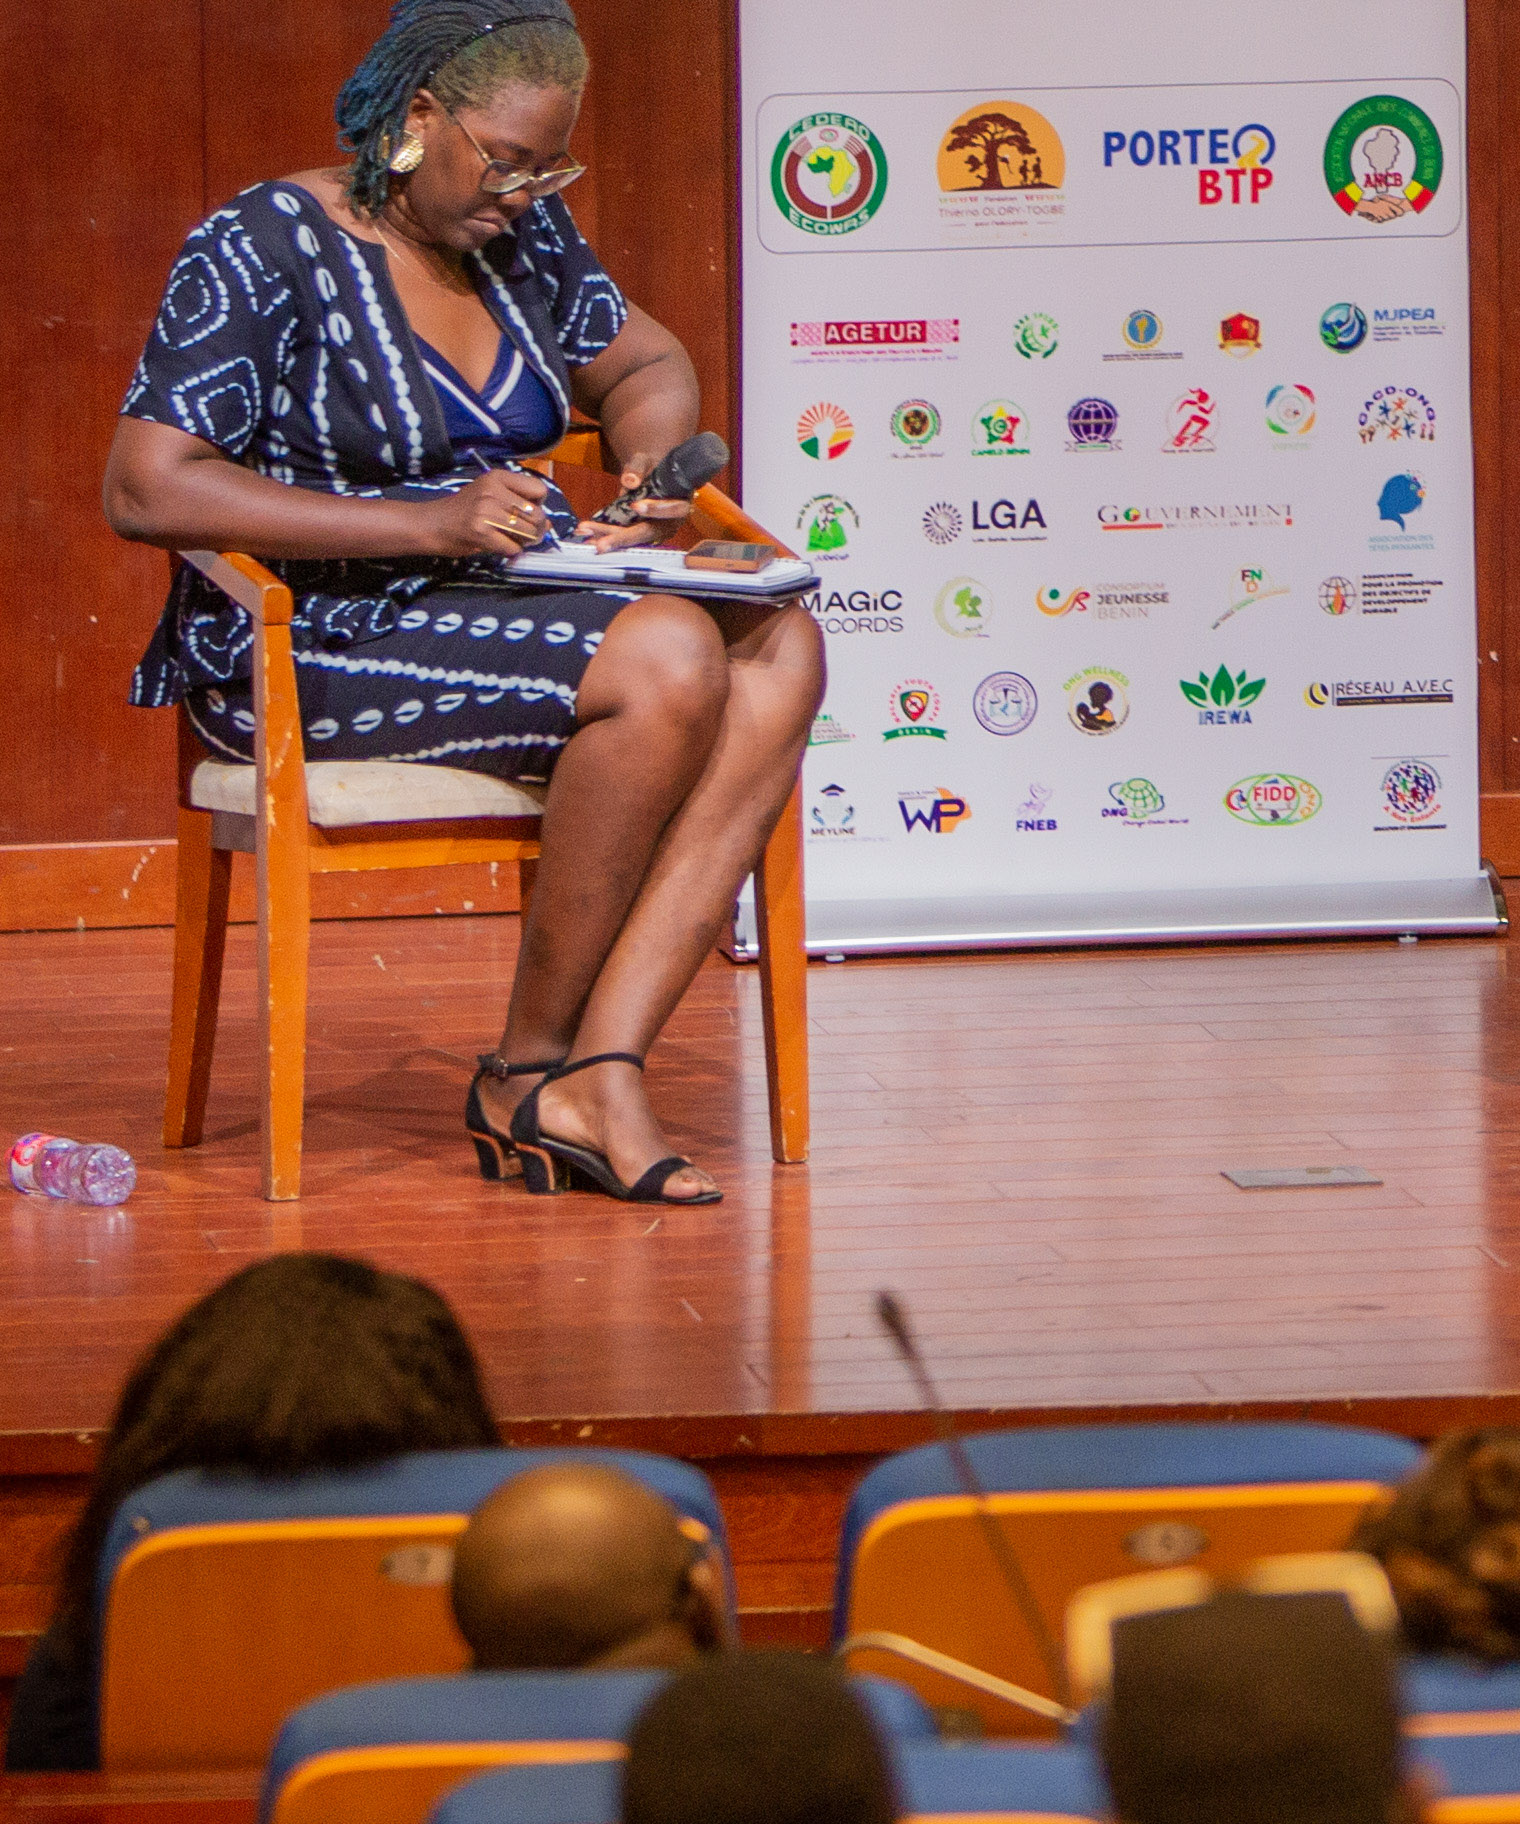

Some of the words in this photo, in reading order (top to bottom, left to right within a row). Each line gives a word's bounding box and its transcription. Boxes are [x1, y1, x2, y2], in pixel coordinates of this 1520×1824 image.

[1199, 168, 1275, 205] BTP
[826, 322, 923, 343] AGETUR
[972, 498, 1048, 530] LGA
[1096, 592, 1169, 605] JEUNESSE
[817, 617, 905, 634] CORDS
[1336, 679, 1395, 696] RÉSEAU
[1402, 678, 1454, 694] A.V.E.C
[1199, 710, 1253, 725] IREWA
[1253, 786, 1297, 802] FIDD
[811, 827, 856, 837] MEYLINE
[1016, 819, 1058, 832] FNEB
